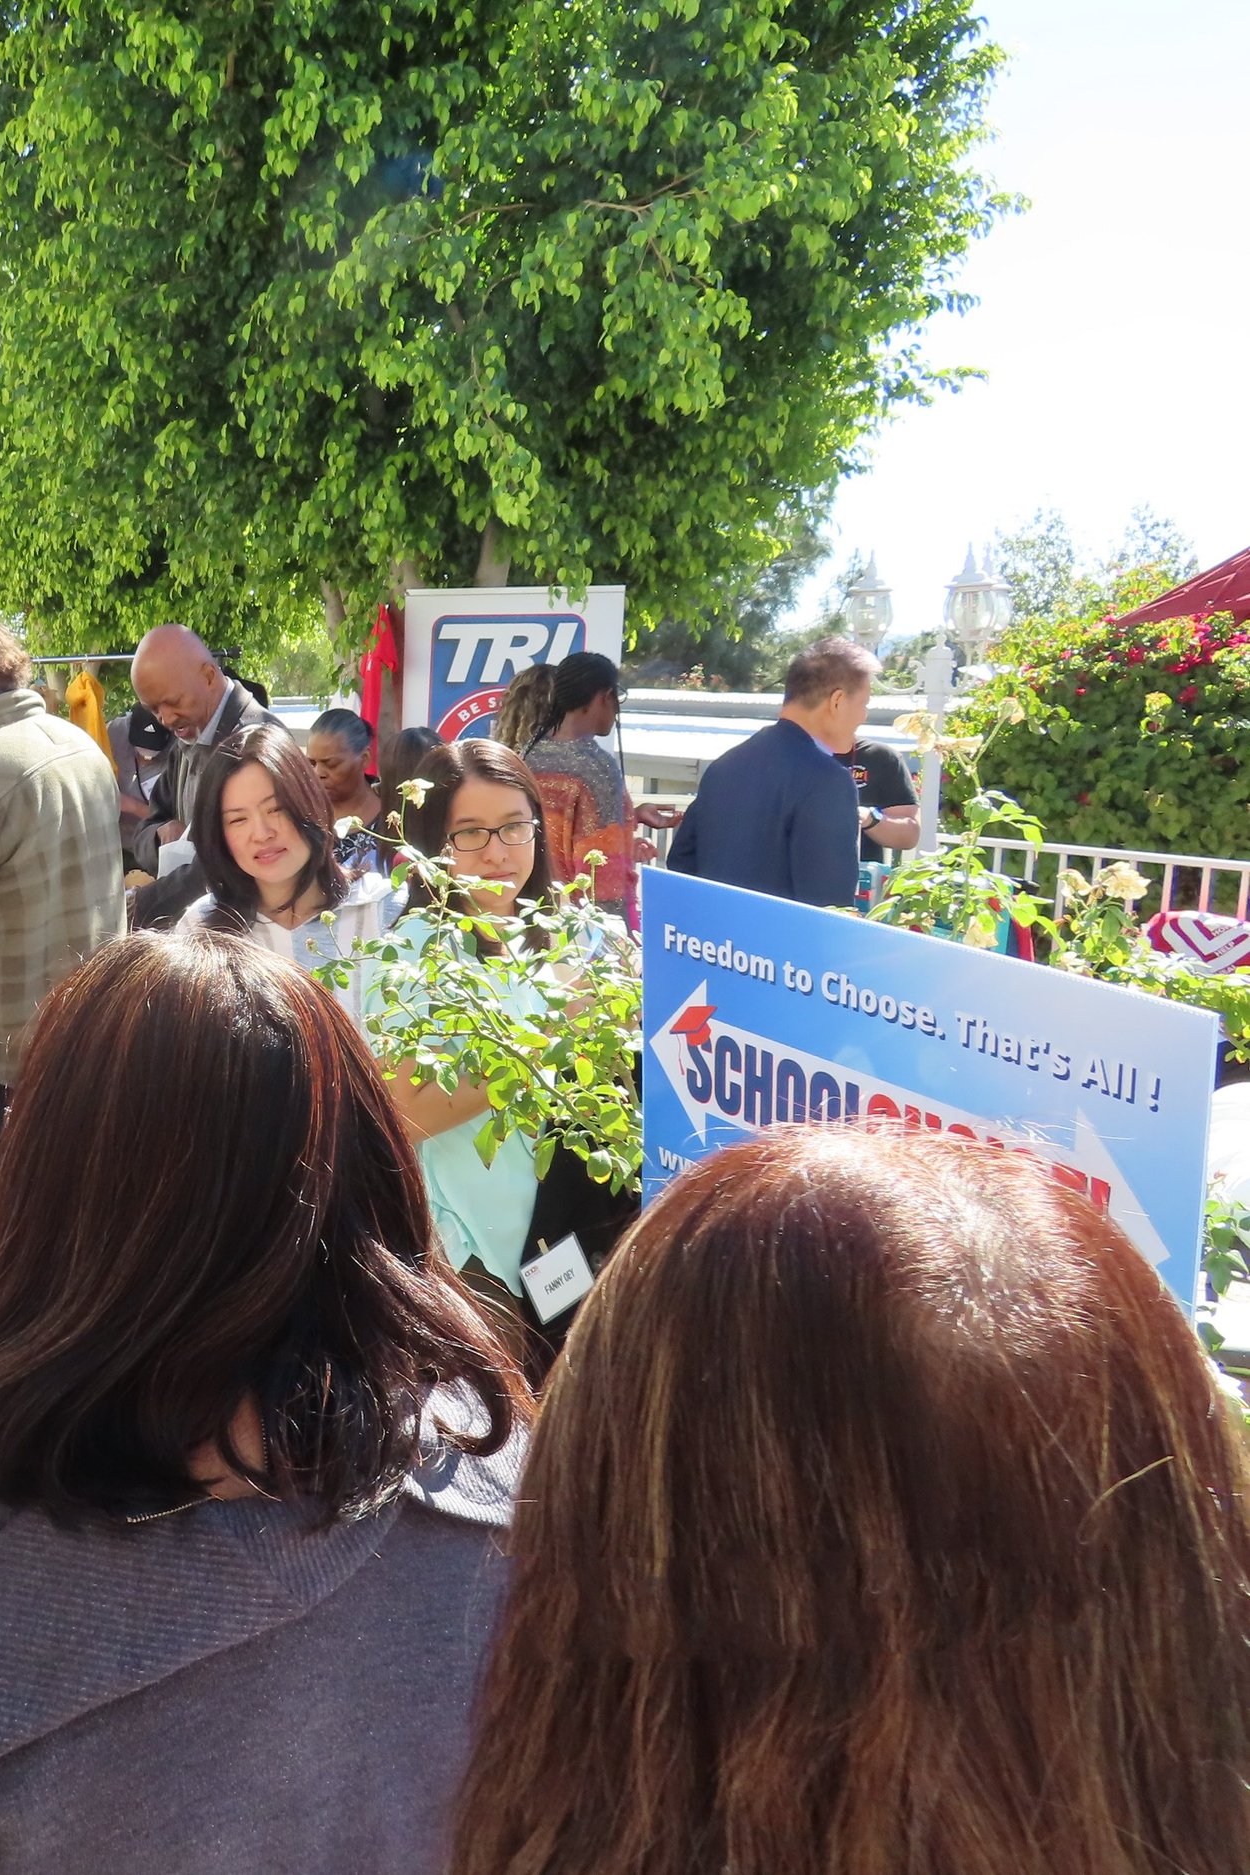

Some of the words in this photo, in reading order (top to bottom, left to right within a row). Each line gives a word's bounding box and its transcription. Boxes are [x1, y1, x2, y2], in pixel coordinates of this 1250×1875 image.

[438, 622, 578, 683] TRI
[457, 702, 481, 722] BE
[1214, 941, 1235, 957] HELP
[663, 923, 776, 984] Freedom
[783, 960, 813, 995] to
[821, 971, 946, 1040] Choose.
[955, 1010, 1072, 1081] That's
[1081, 1053, 1137, 1105] All
[544, 1275, 564, 1295] FANNY
